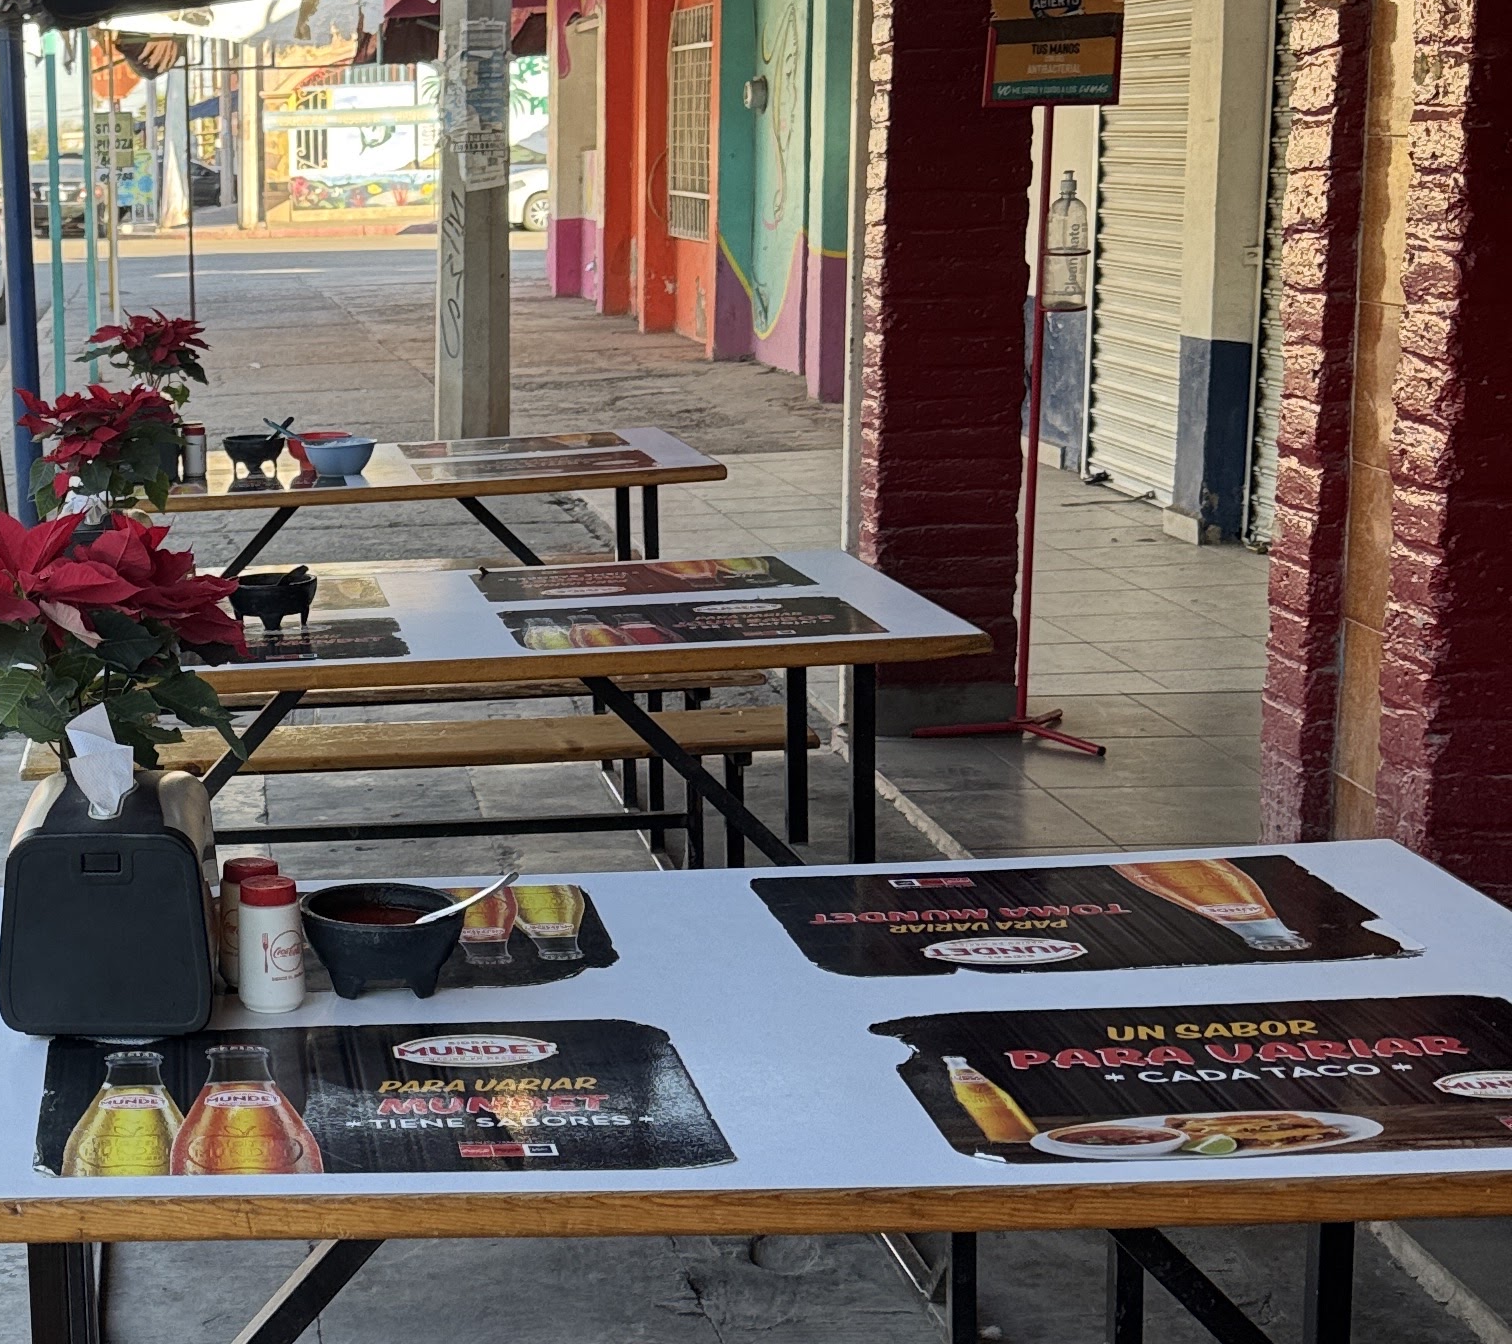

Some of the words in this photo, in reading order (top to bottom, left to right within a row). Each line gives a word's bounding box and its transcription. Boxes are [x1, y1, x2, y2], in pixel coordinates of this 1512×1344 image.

[1032, 43, 1048, 56] TUS
[1049, 43, 1081, 55] MANOS
[810, 907, 991, 926] MUNDET
[999, 902, 1134, 917] TOMA
[889, 920, 991, 936] VARIAR
[995, 918, 1069, 933] PARA
[930, 942, 1082, 958] MUNDET
[1106, 1025, 1170, 1042] UN
[1174, 1019, 1320, 1041] SABOR
[396, 1042, 551, 1058] MUNDET
[1003, 1047, 1198, 1071] PARA
[1203, 1033, 1472, 1065] VARIAR
[1137, 1066, 1258, 1083] CADA
[1258, 1062, 1383, 1081] TACO
[377, 1079, 467, 1094] PARA
[474, 1076, 599, 1093] VARIAR
[376, 1094, 611, 1116] MUNDET
[368, 1117, 466, 1130] TIENE
[475, 1113, 633, 1129] SABORES
